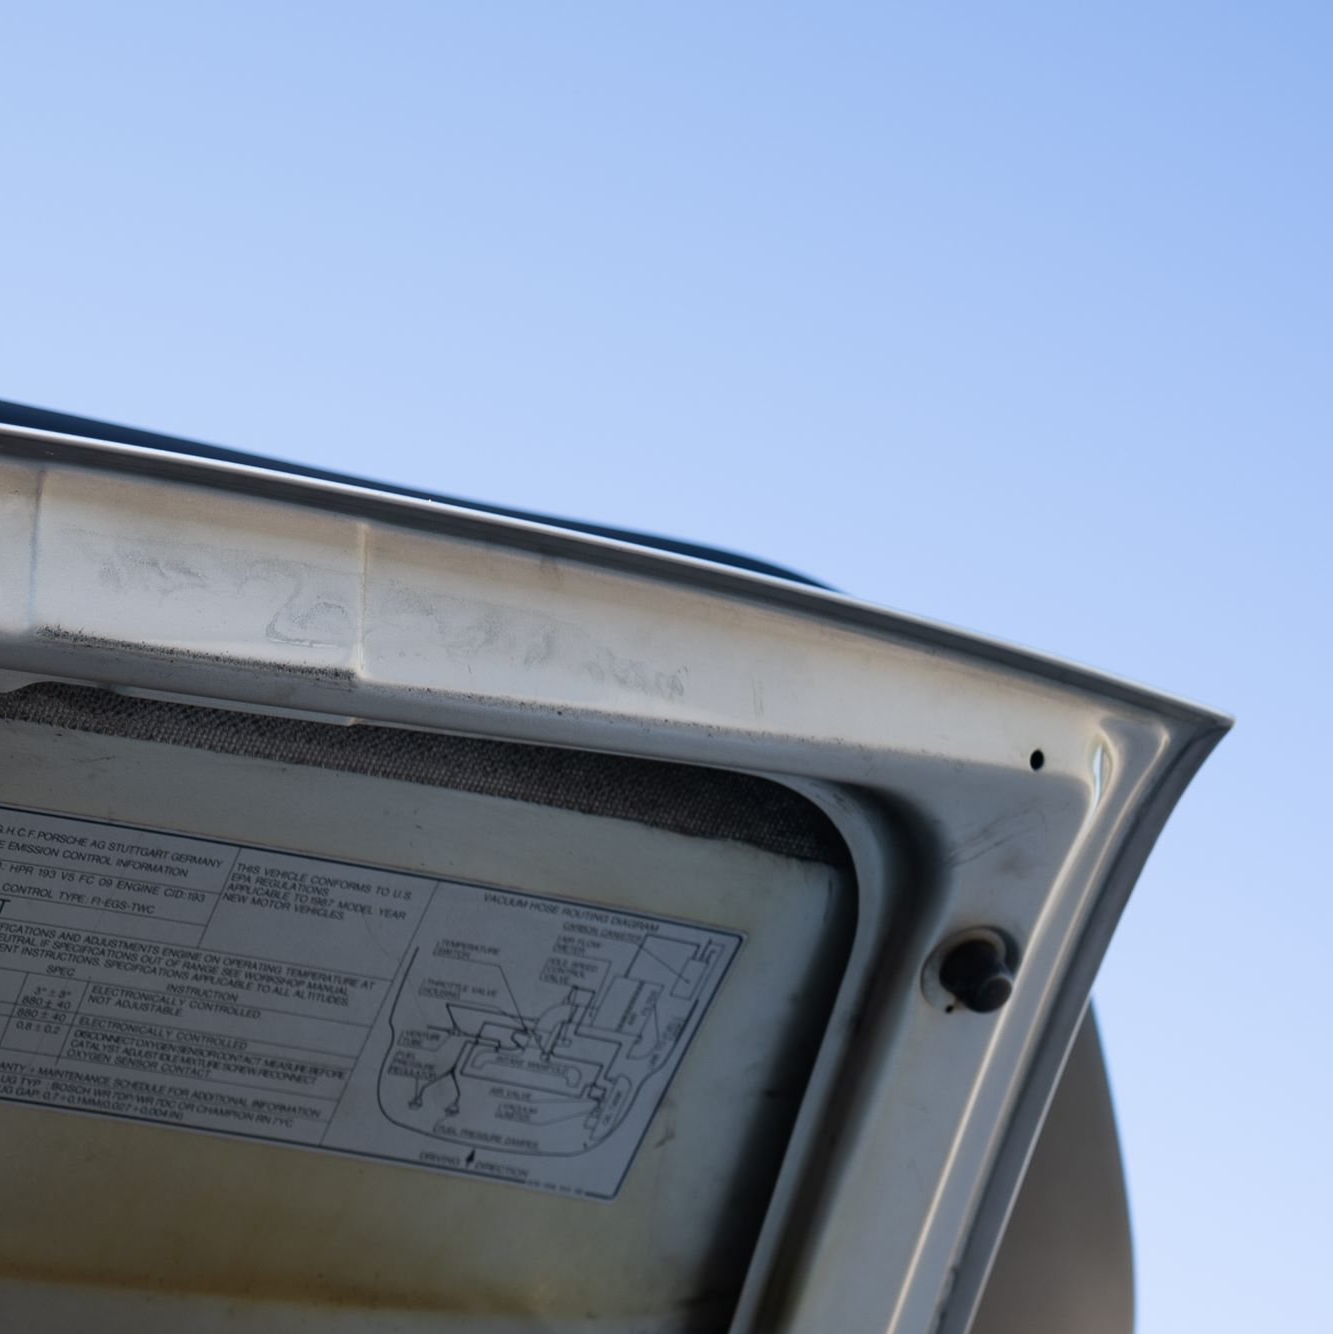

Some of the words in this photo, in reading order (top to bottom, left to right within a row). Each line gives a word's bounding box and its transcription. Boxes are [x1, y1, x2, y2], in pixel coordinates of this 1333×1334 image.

[6, 841, 60, 857] EMISSION
[61, 850, 113, 865] CONTROL
[115, 858, 189, 877] INFORMATION
[89, 839, 107, 850] AG
[107, 842, 171, 860] STUTTGART
[170, 852, 223, 868] GERMANY
[0, 882, 55, 899] CONTROL
[9, 864, 34, 875] HPR
[36, 868, 56, 878] 193
[78, 875, 95, 885] FC
[97, 878, 113, 887] 09
[115, 881, 160, 895] ENGINE
[230, 873, 252, 884] EPA
[235, 863, 261, 874] THIS
[262, 867, 308, 882] VEHICLE
[308, 875, 372, 893] CONFORMS
[374, 886, 391, 896] TO
[221, 892, 248, 904] NEW
[249, 897, 291, 911] MOTOR
[226, 883, 290, 901] APPLICABLE
[292, 894, 311, 904] TO
[335, 901, 374, 915] MODEL
[377, 908, 407, 920] YEAR
[481, 893, 529, 909] VACUUM
[528, 901, 560, 914] HOSE
[560, 907, 611, 923] ROUTING
[609, 915, 661, 932] DIAGRAM
[38, 939, 51, 948] IF
[51, 941, 139, 962] SPECIFICATIONS
[139, 954, 163, 965] OUT
[163, 958, 180, 968] OF
[181, 961, 219, 974] RANGE
[219, 967, 242, 978] SEE
[242, 971, 306, 988] WORKSHOP
[45, 965, 76, 977] SPEC
[57, 931, 82, 943] AND
[83, 935, 160, 955] ADJUSTMENTS
[160, 948, 202, 962] ENGINE
[202, 954, 221, 965] ON
[221, 957, 283, 974] OPERATING
[284, 967, 359, 986] TEMPERATURE
[359, 979, 375, 989] AT
[102, 959, 190, 980] SPECIFICATIONS
[190, 972, 254, 990] APPLICABLE
[255, 983, 272, 993] TO
[271, 985, 292, 996] ALL
[165, 983, 239, 1002] INSTRUCTION
[86, 994, 111, 1005] NOT
[90, 984, 186, 1007] ELECTRONICALLY
[78, 1016, 173, 1038] ELECTRONICALLY
[65, 1048, 111, 1063] OXYGEN
[112, 1056, 159, 1070] SENSOR
[69, 1039, 121, 1054] CATALYST
[121, 1047, 158, 1060] ADJUST
[157, 1052, 179, 1063] IDLE
[256, 1068, 318, 1085] RECONNECT
[73, 1029, 135, 1046] DISCONNECT
[134, 1039, 178, 1053] OXYGEN
[176, 1045, 218, 1059] SENSOR
[216, 1052, 261, 1066] CONTACT
[262, 1059, 306, 1073] MEASURE
[36, 1067, 110, 1085] MAINTENANCE
[112, 1079, 167, 1094] SCHEDULE
[165, 1087, 190, 1097] FOR
[190, 1091, 247, 1106] ADDITIONAL
[250, 1100, 322, 1118] INFORMATION
[49, 1081, 91, 1095] BOSCH
[91, 1088, 112, 1098] WR
[176, 1101, 196, 1112] OR
[194, 1104, 255, 1121] CHAMPION
